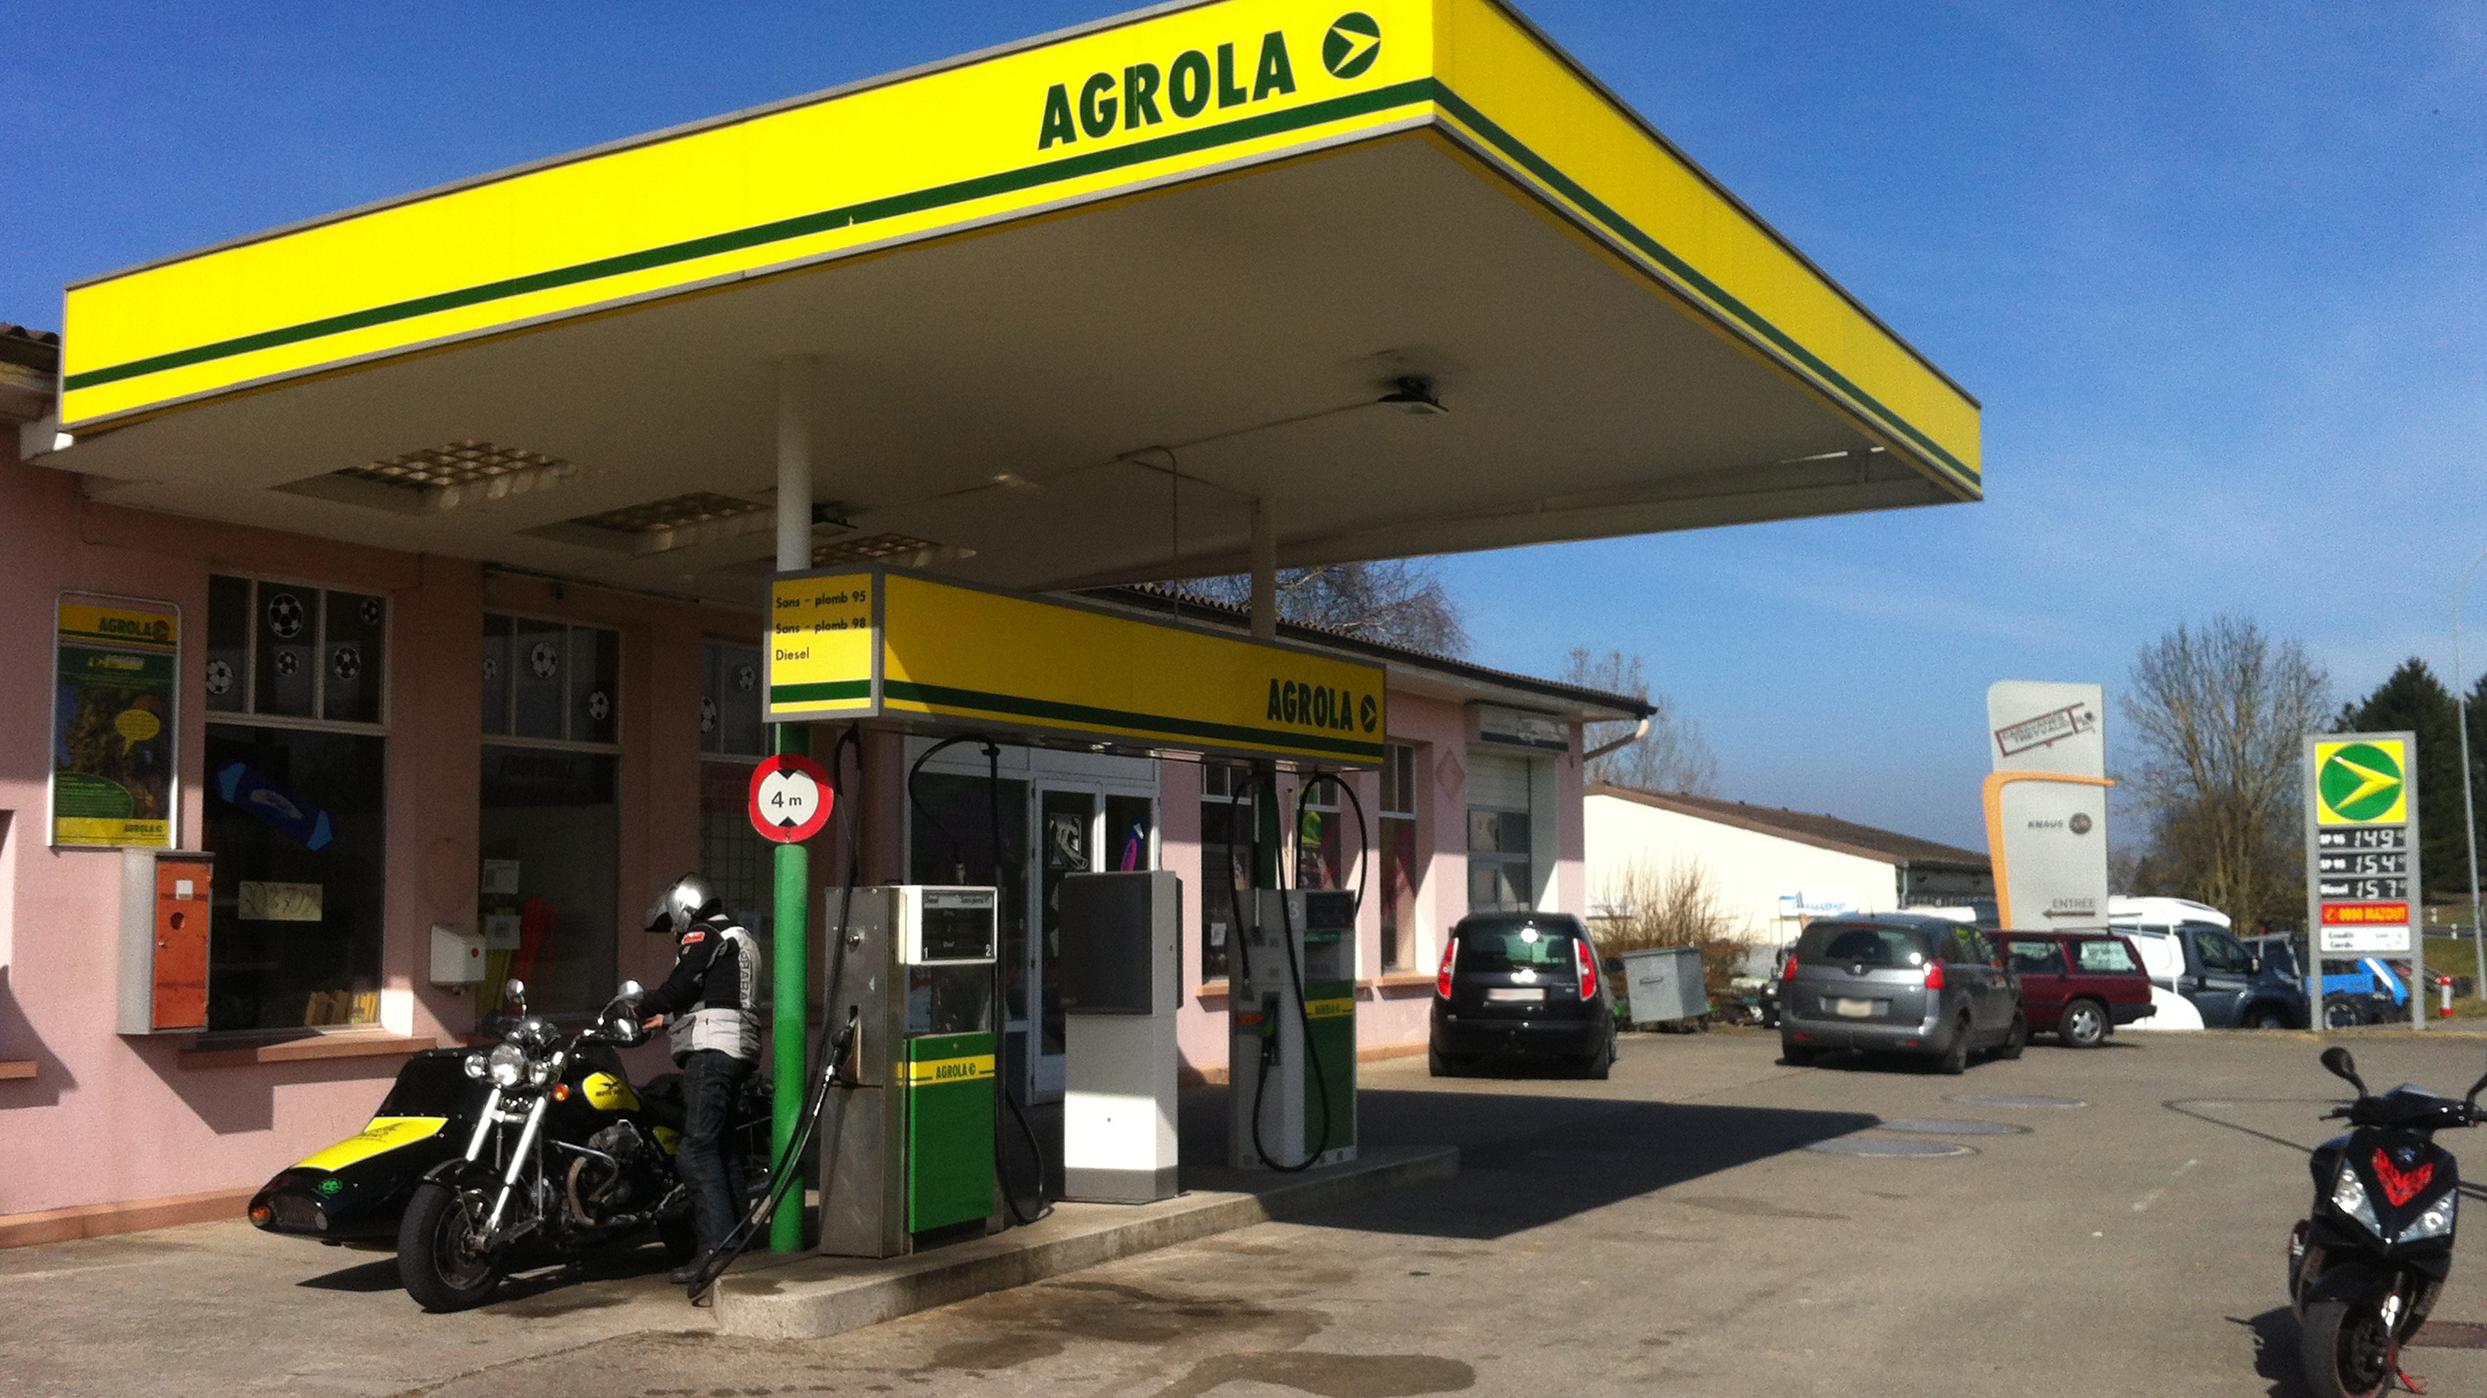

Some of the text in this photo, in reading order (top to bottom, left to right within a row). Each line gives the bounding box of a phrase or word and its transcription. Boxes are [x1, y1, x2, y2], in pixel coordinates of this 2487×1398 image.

[1038, 31, 1296, 151] AGROLA
[776, 597, 800, 608] Sans
[815, 592, 848, 607] plomb
[852, 591, 866, 602] 95
[776, 623, 800, 634] Sans
[814, 619, 848, 634] plomb
[852, 617, 866, 628] 98
[776, 647, 810, 661] Diesel
[1267, 678, 1353, 731] AGROLA
[771, 790, 802, 808] 4 m
[923, 946, 929, 959] 1
[985, 944, 992, 957] 2
[936, 1064, 967, 1079] AGROLA
